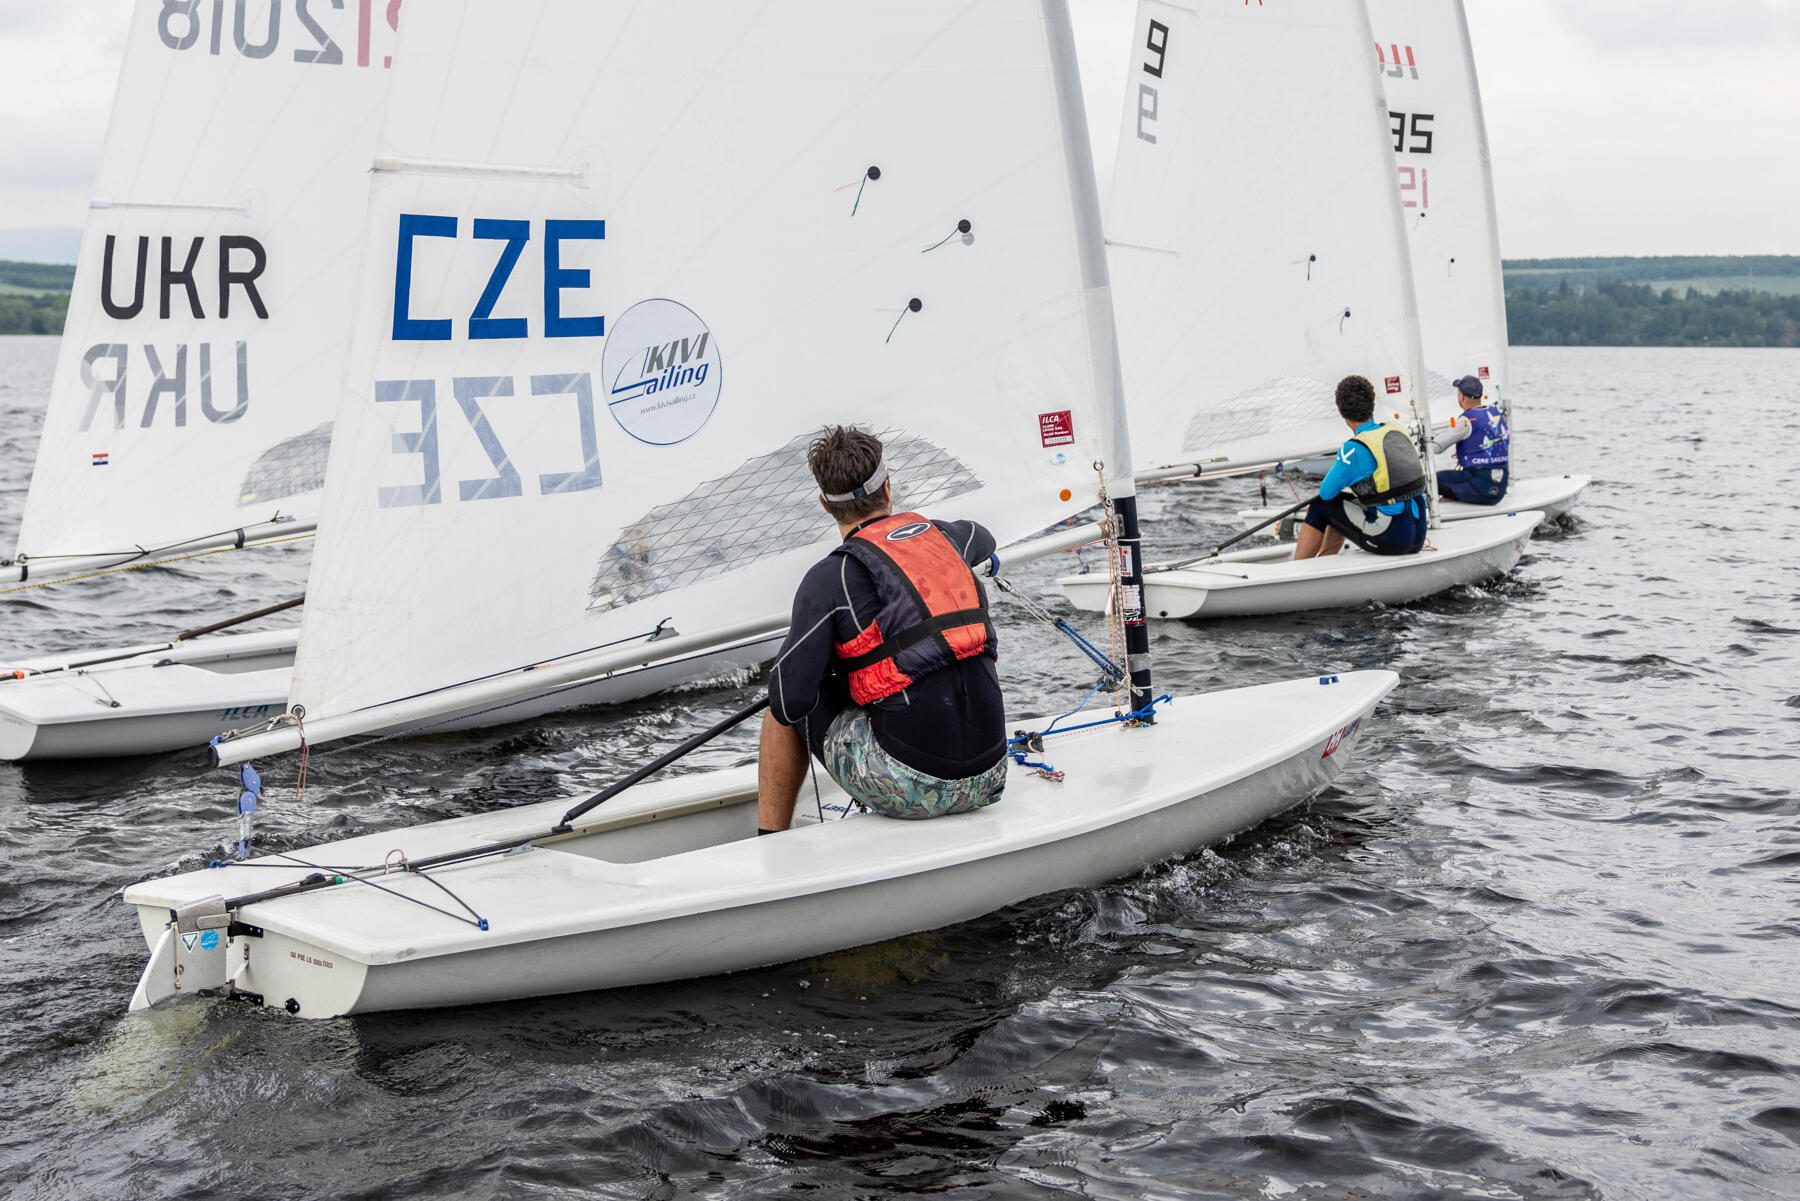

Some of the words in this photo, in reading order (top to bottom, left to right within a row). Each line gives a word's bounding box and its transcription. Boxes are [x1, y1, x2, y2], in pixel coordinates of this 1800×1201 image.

[101, 234, 269, 320] UKR
[391, 213, 606, 341] CZE
[646, 332, 710, 374] KIVI
[1042, 415, 1059, 424] ILCA
